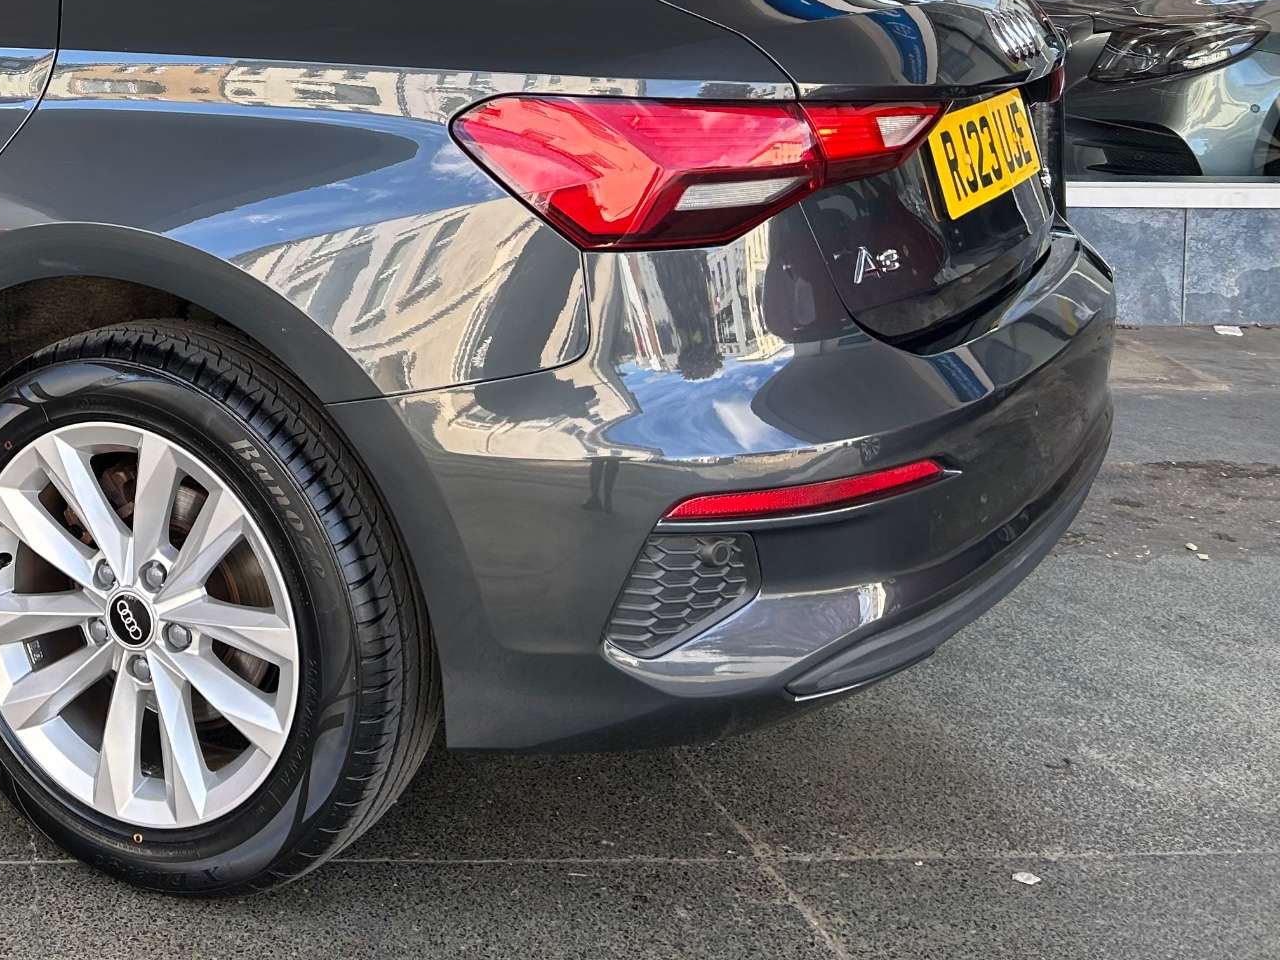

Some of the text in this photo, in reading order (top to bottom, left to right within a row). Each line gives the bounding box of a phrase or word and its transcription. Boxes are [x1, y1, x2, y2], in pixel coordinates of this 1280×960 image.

[940, 101, 1032, 201] RJ23 UJE
[854, 246, 900, 284] A3
